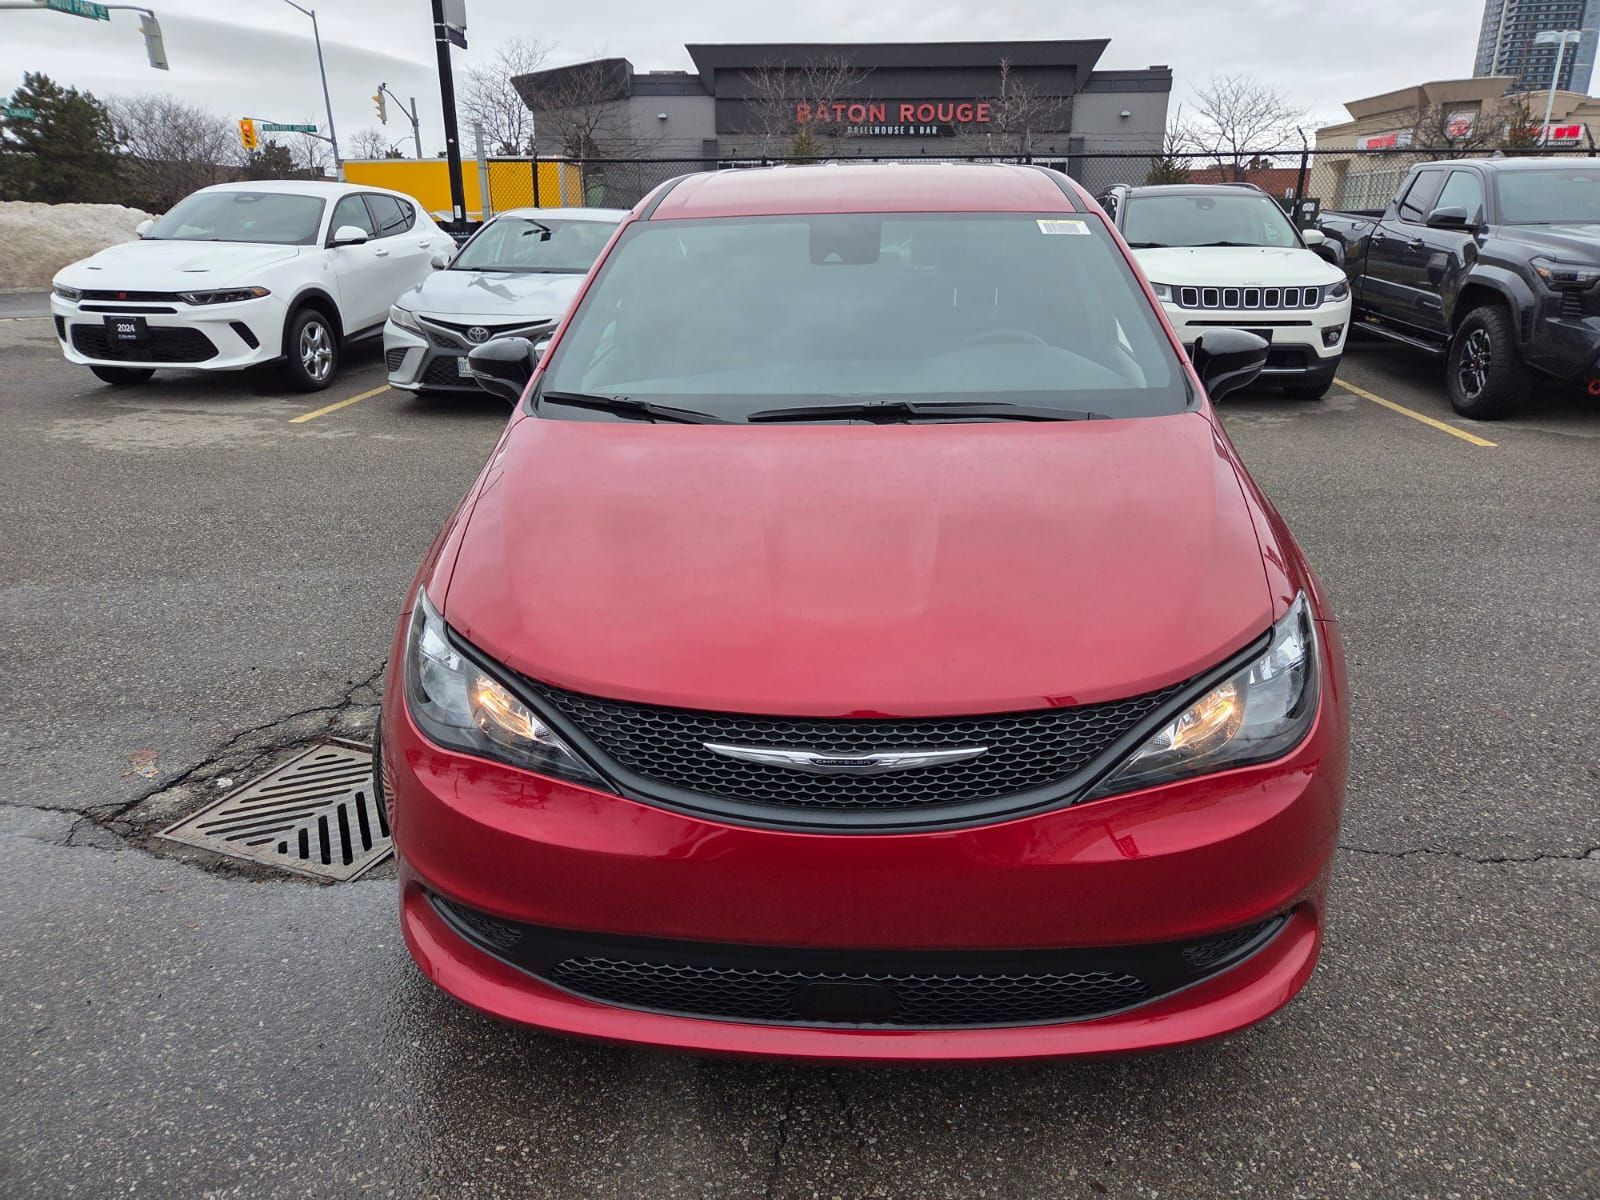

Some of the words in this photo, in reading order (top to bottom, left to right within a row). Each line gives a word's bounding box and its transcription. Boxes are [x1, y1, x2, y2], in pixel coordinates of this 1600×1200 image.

[74, 0, 96, 16] PARK
[899, 103, 991, 123] ROUGE
[909, 126, 914, 134] &
[919, 126, 937, 134] BAR
[117, 323, 135, 332] 2024
